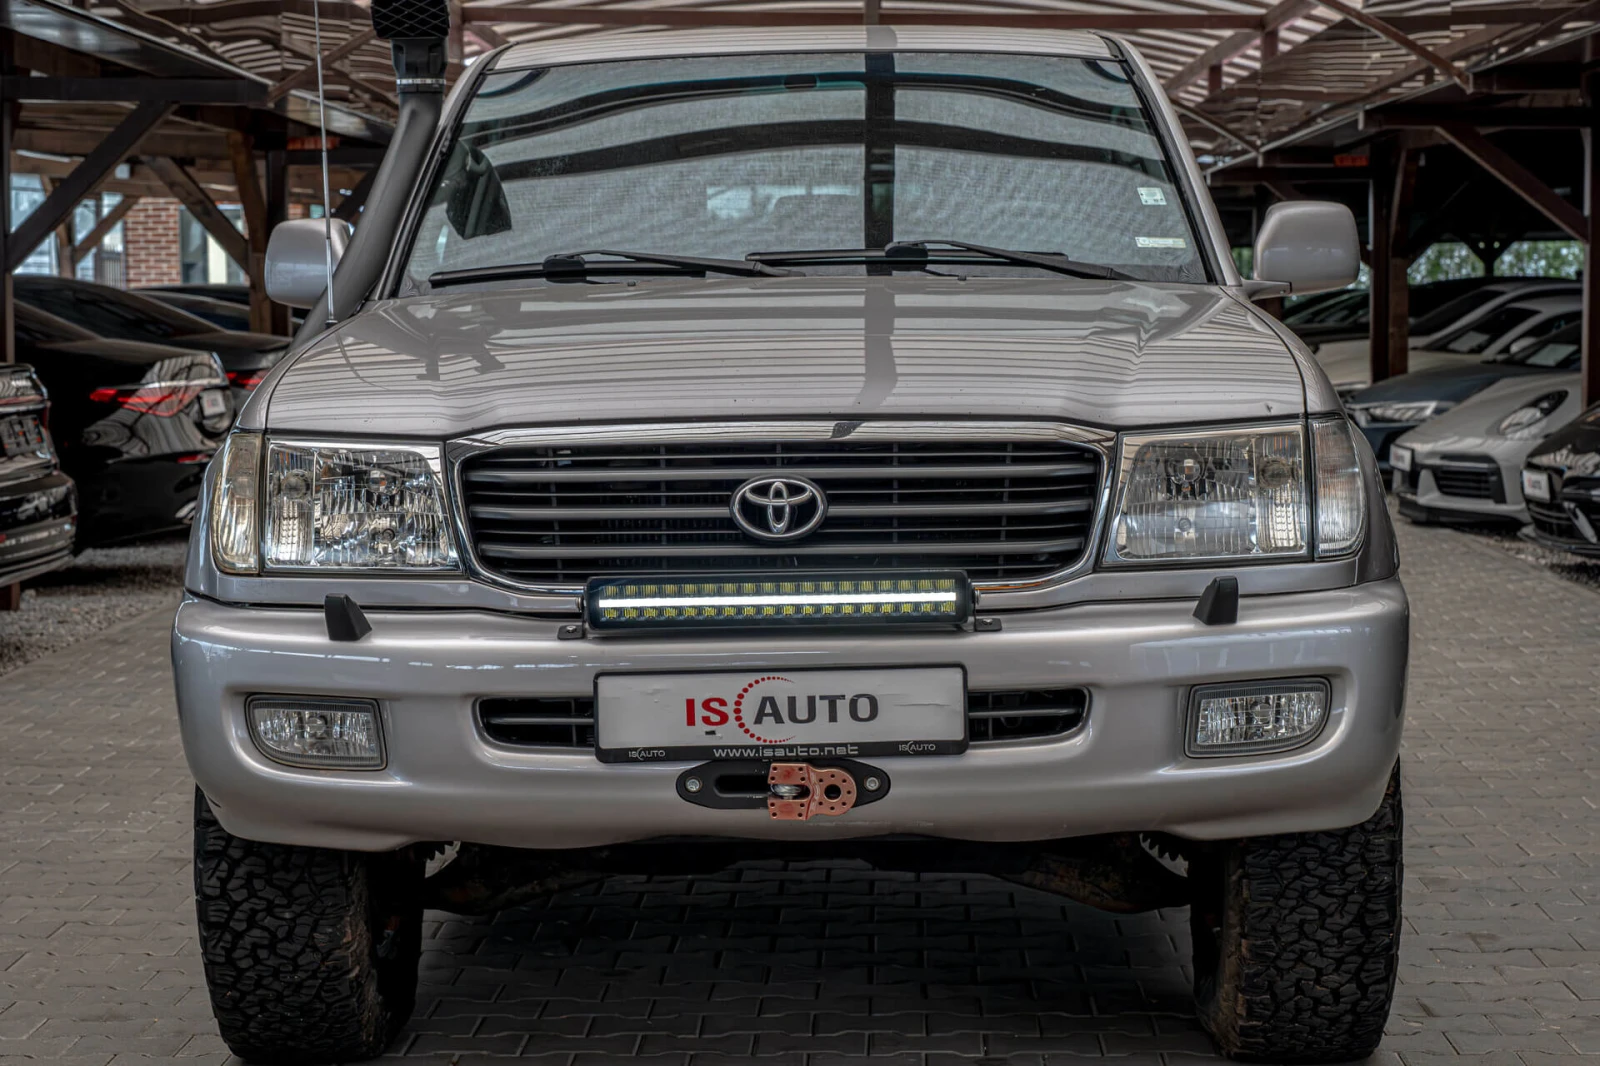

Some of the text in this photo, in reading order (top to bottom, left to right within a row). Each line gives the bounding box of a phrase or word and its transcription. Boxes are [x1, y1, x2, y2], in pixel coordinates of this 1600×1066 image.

[685, 693, 879, 727] IS AUTO
[713, 744, 859, 757] www.isauto.net
[910, 743, 936, 751] AUTO
[640, 750, 666, 758] AUTO
